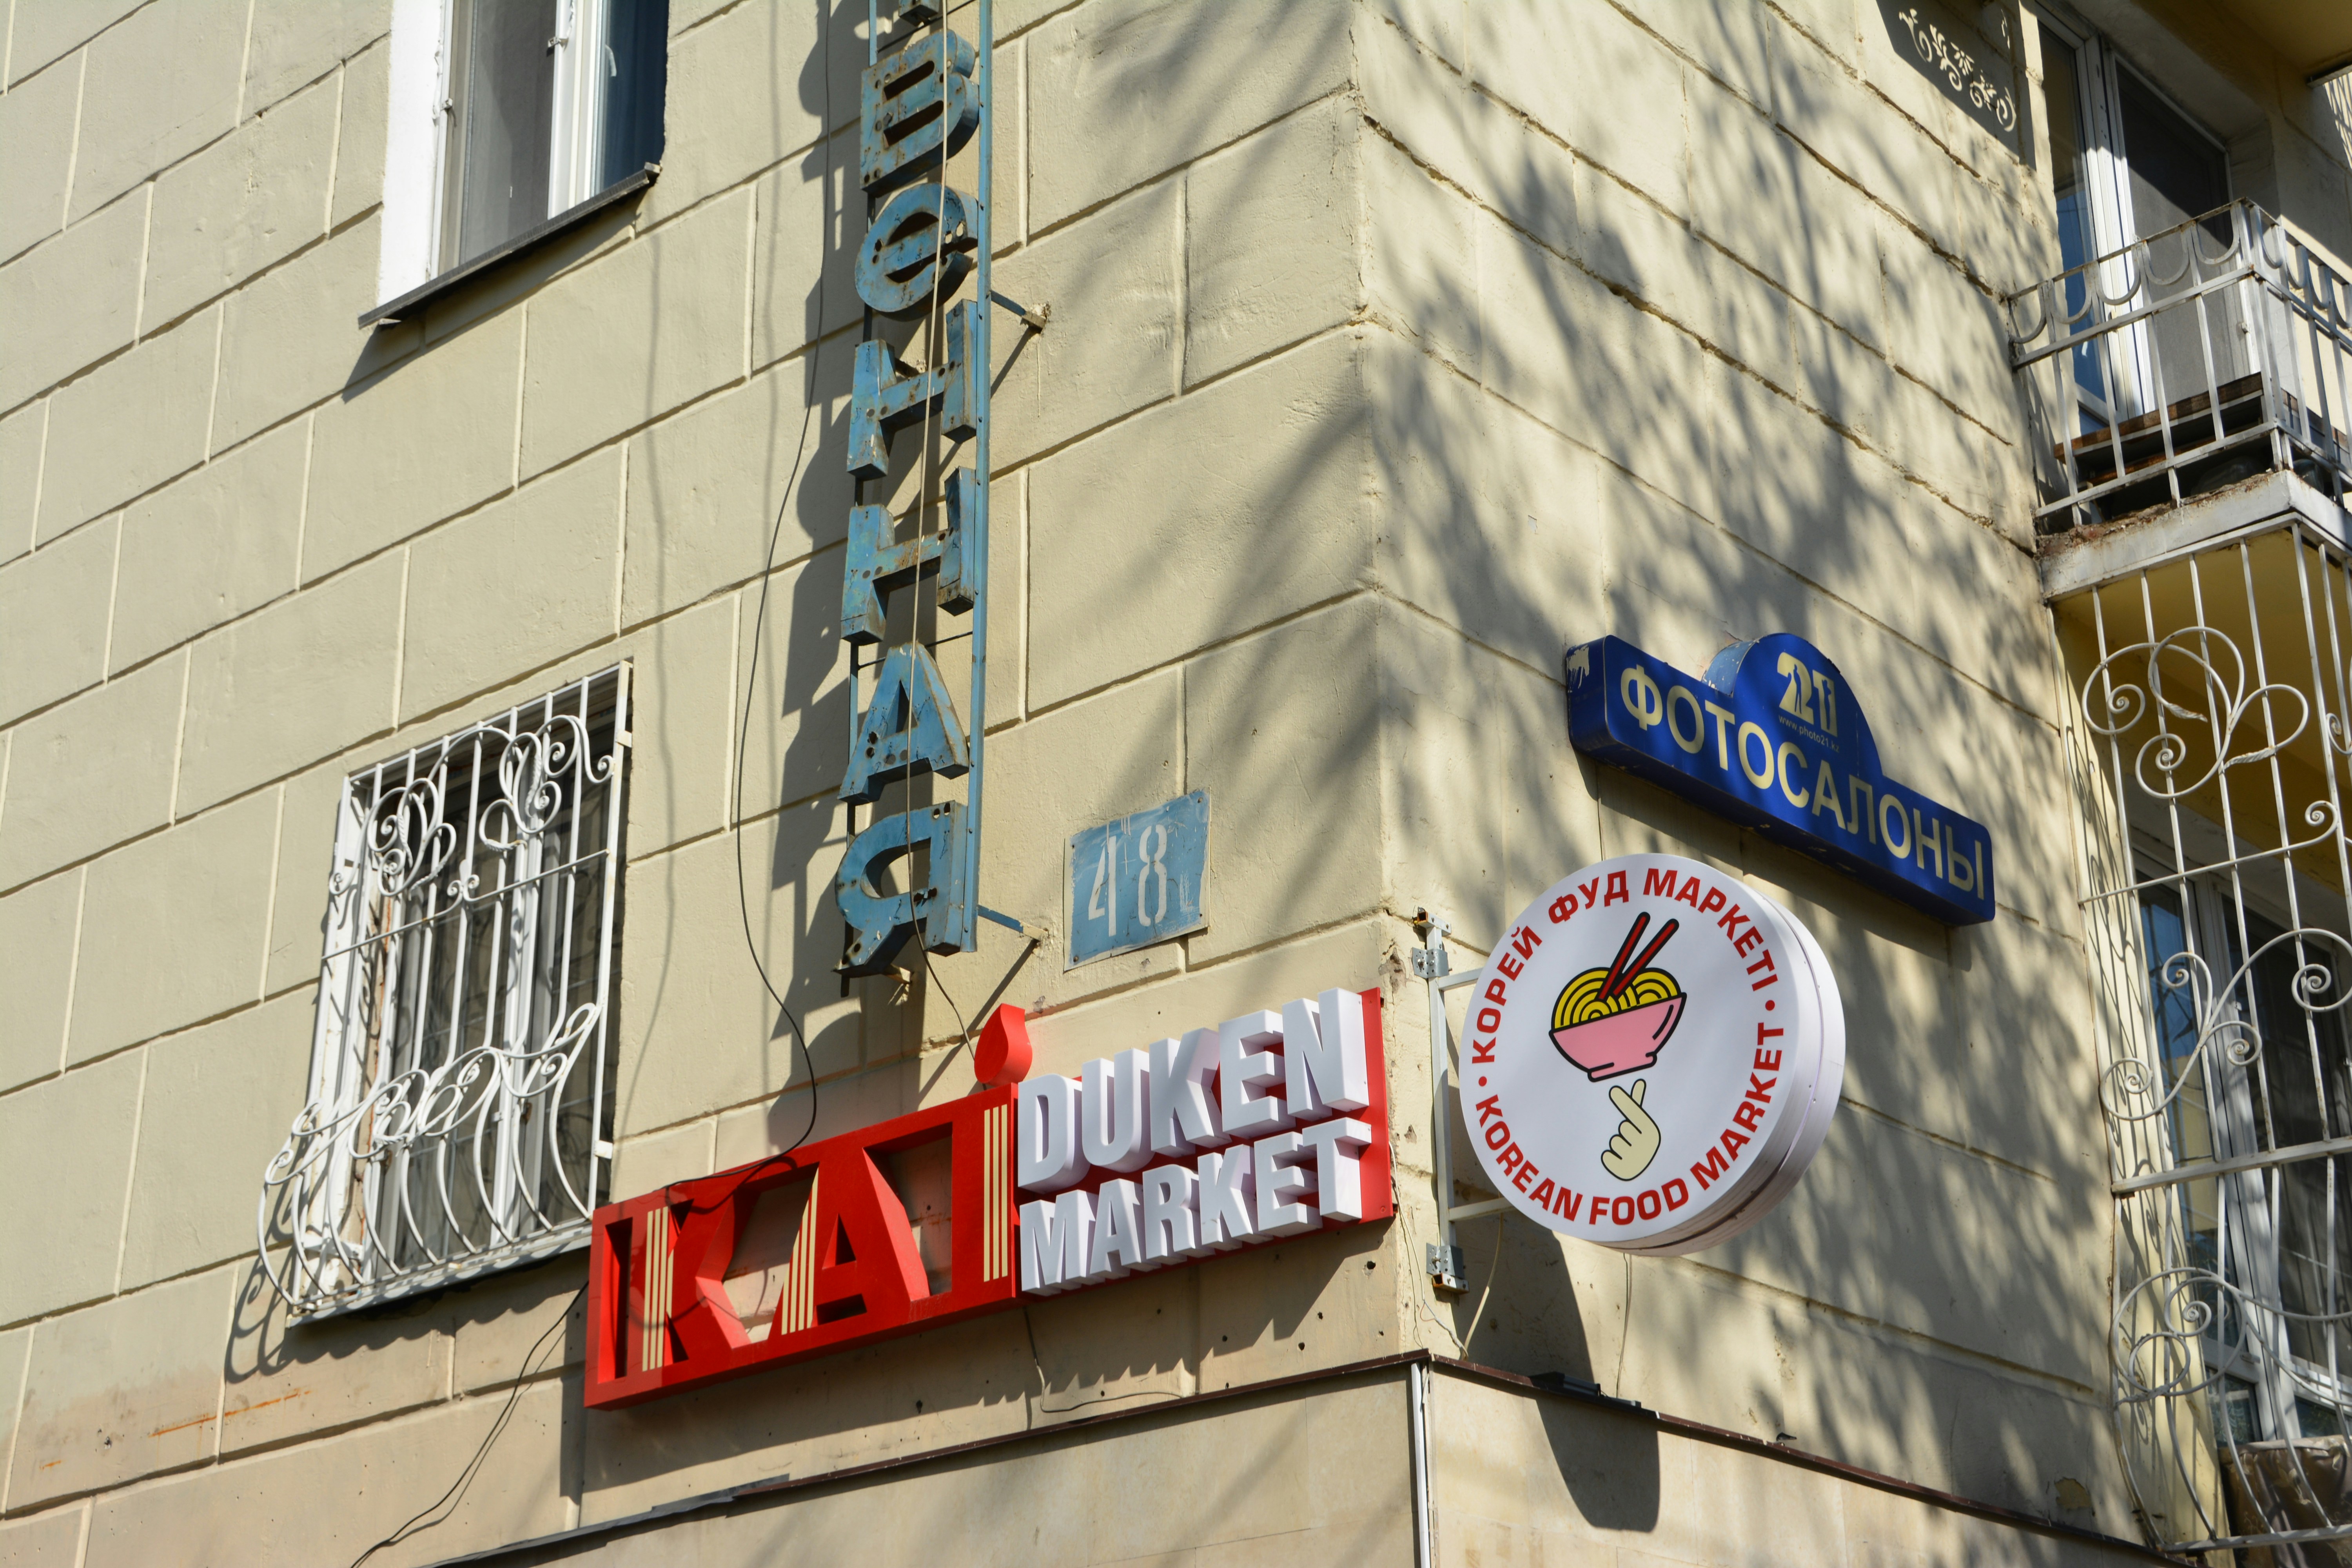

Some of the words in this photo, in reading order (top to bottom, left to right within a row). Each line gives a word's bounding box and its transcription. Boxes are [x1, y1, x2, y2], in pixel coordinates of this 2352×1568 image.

[1620, 663, 1985, 900] ФОТОСАЛОНЫ
[1777, 652, 1838, 738] 21
[1778, 714, 1840, 753] www.photo21.kz
[1088, 824, 1167, 937] 48
[1472, 927, 1543, 1065] КОРЕЙ
[1548, 870, 1629, 924] ФУД
[1643, 868, 1779, 991] МАРКЕТІ
[1018, 987, 1369, 1194] DUKEN
[1475, 1094, 1583, 1221] KOREAN
[1589, 1178, 1689, 1225] FOOD
[1690, 1022, 1784, 1191] MARKET
[1019, 1117, 1372, 1296] MARKET
